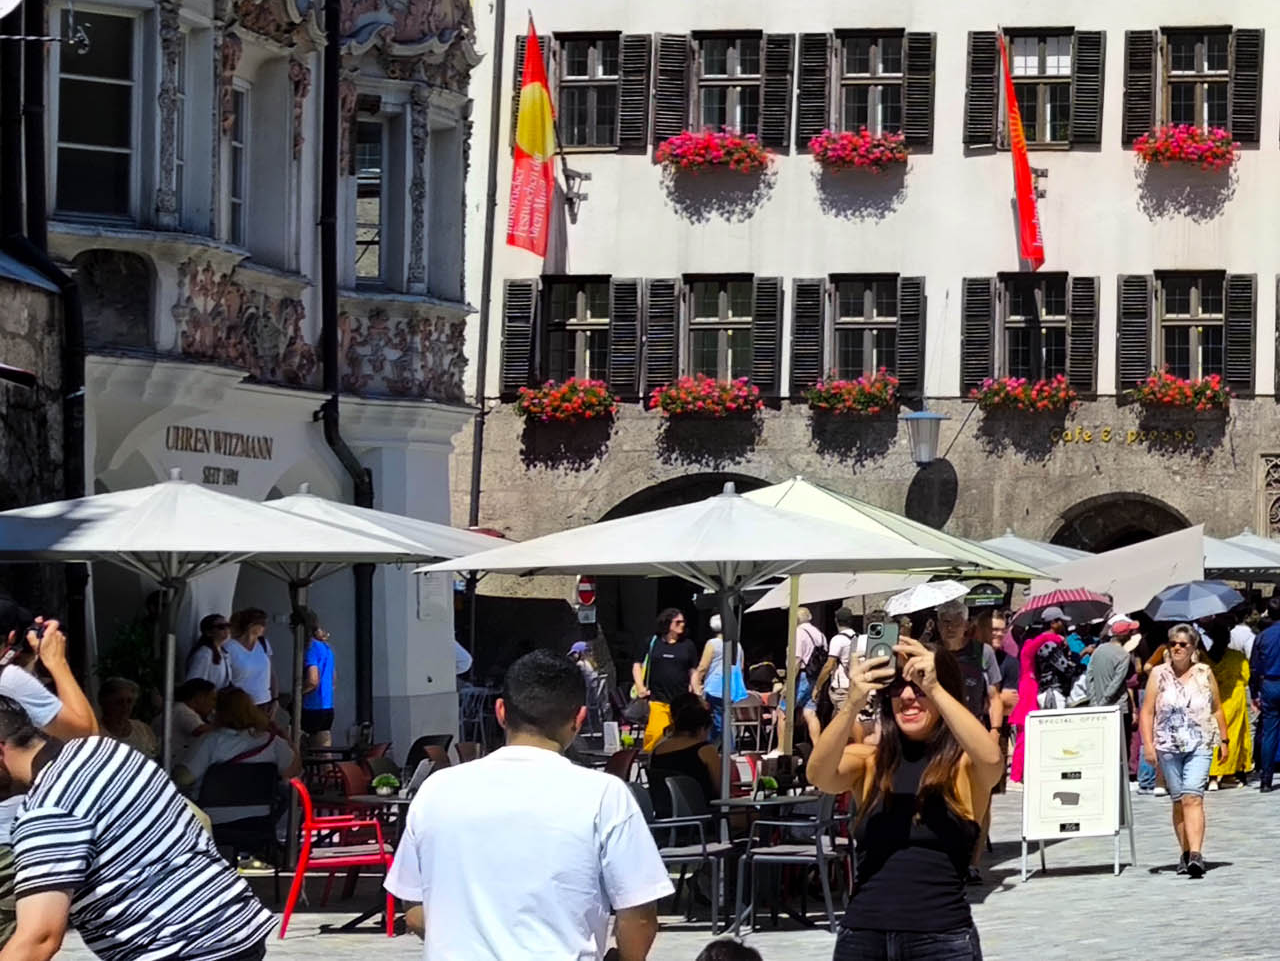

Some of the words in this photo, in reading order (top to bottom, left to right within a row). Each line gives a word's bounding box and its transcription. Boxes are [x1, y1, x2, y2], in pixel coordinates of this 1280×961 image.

[166, 425, 212, 453] UHREN
[213, 430, 273, 460] WITZMANN
[202, 466, 220, 485] SEIT
